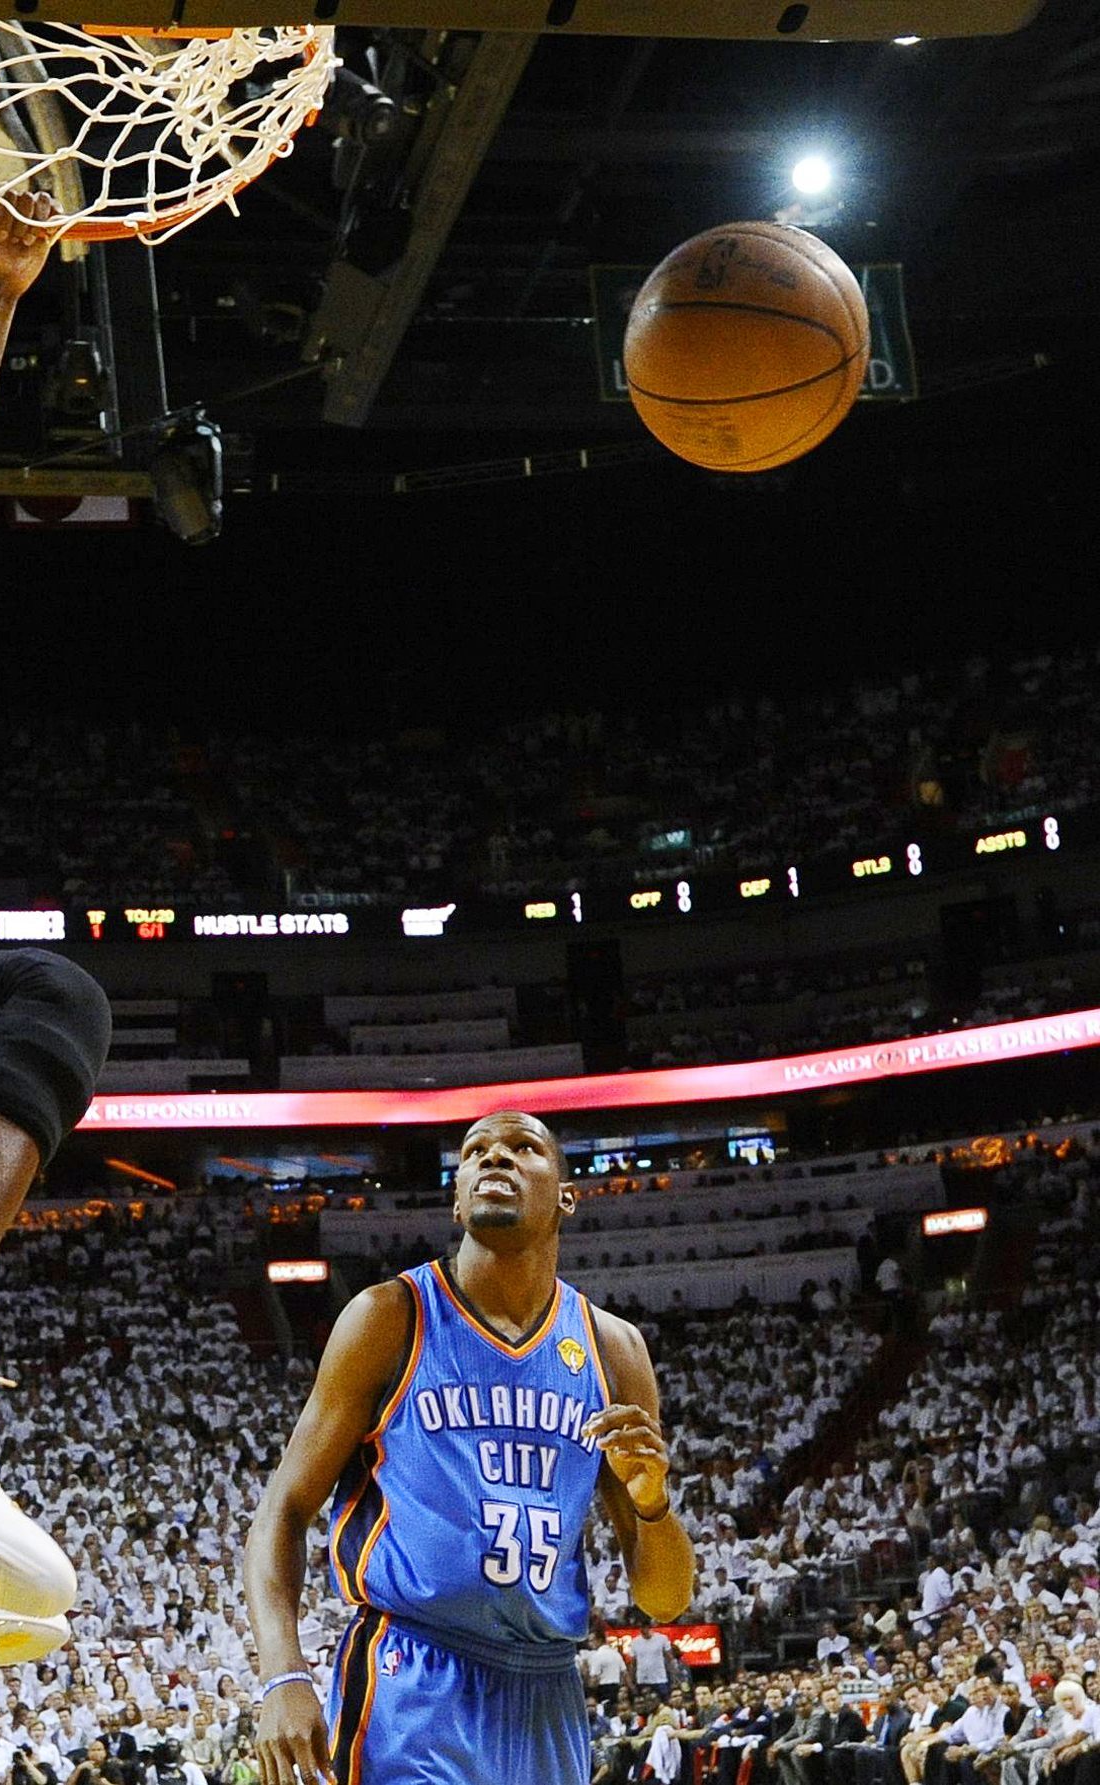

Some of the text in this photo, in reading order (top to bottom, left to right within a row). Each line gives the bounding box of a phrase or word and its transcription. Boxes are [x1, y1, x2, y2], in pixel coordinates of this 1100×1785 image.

[194, 913, 350, 936] HUSTLE STATS
[783, 1056, 872, 1082] BACARDI
[906, 1036, 995, 1066] PLEASE
[1000, 1019, 1082, 1050] DRINK
[478, 1439, 558, 1490] CITY
[480, 1499, 561, 1594] 35
